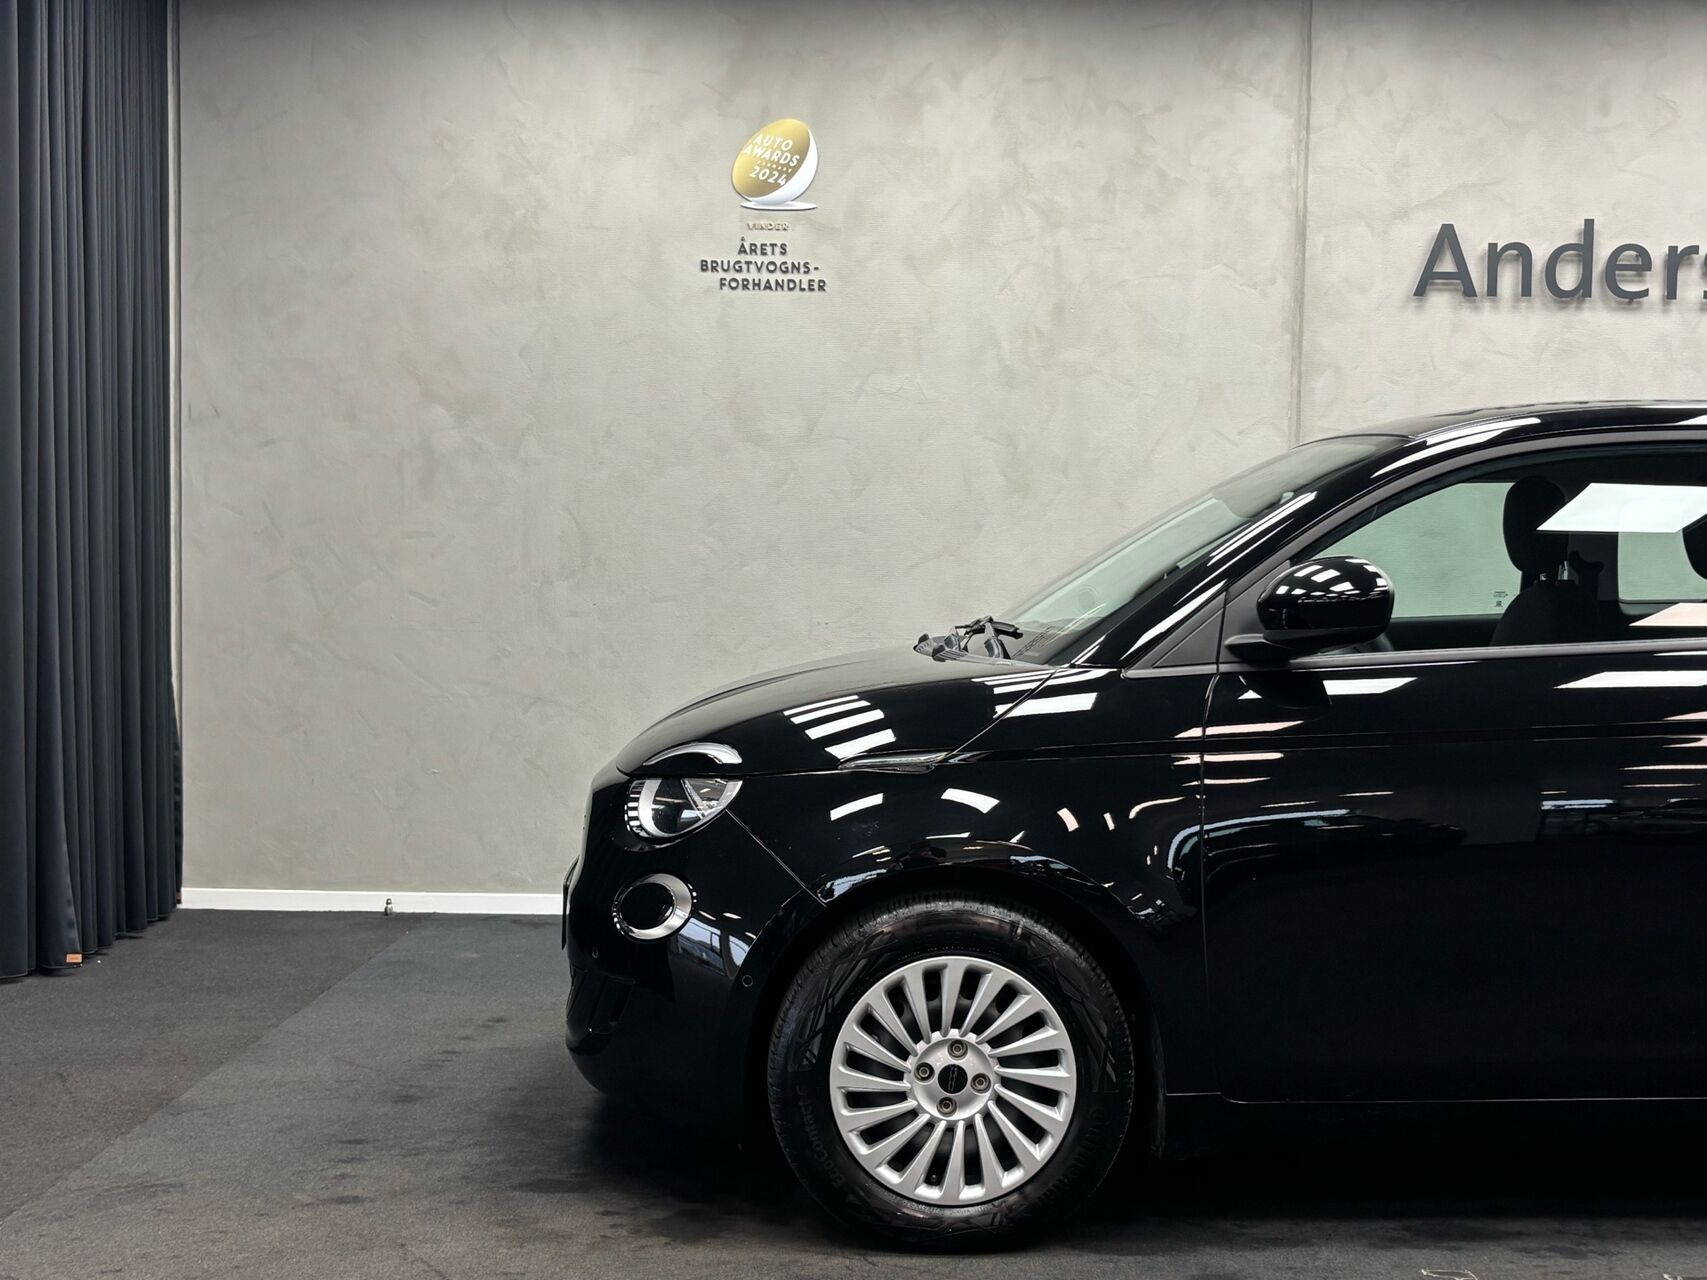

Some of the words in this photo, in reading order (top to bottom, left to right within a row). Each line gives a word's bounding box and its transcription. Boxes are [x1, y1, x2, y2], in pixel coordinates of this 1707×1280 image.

[753, 134, 793, 151] AUTO
[743, 143, 800, 167] AWARDS
[749, 165, 787, 186] 2024
[737, 237, 788, 256] ÅRETS
[700, 259, 820, 275] BRUGTVOGNS-
[1413, 218, 1707, 300] Ander
[720, 278, 827, 292] FORHANDLER
